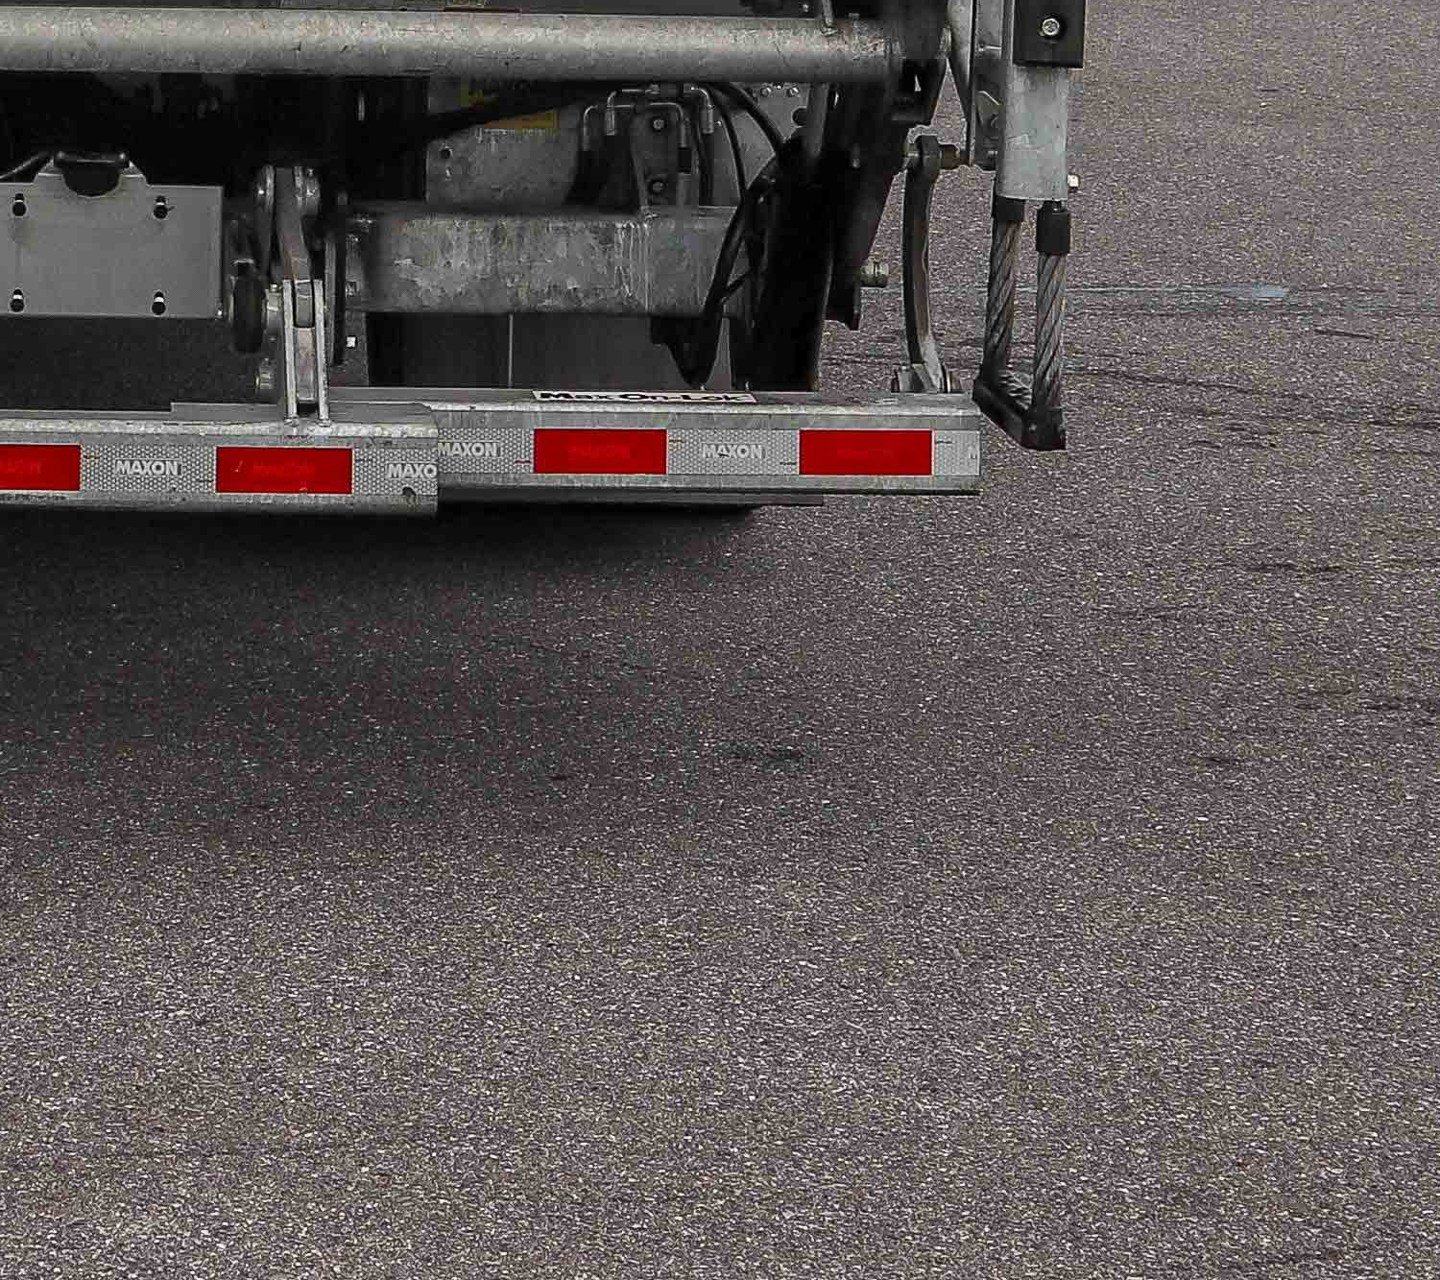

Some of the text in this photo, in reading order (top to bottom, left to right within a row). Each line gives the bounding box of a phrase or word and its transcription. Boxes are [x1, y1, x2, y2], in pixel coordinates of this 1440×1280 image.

[438, 442, 498, 457] MAXON
[702, 444, 763, 459] MAXON
[115, 460, 179, 475] MAXON
[387, 463, 437, 479] MAXO
